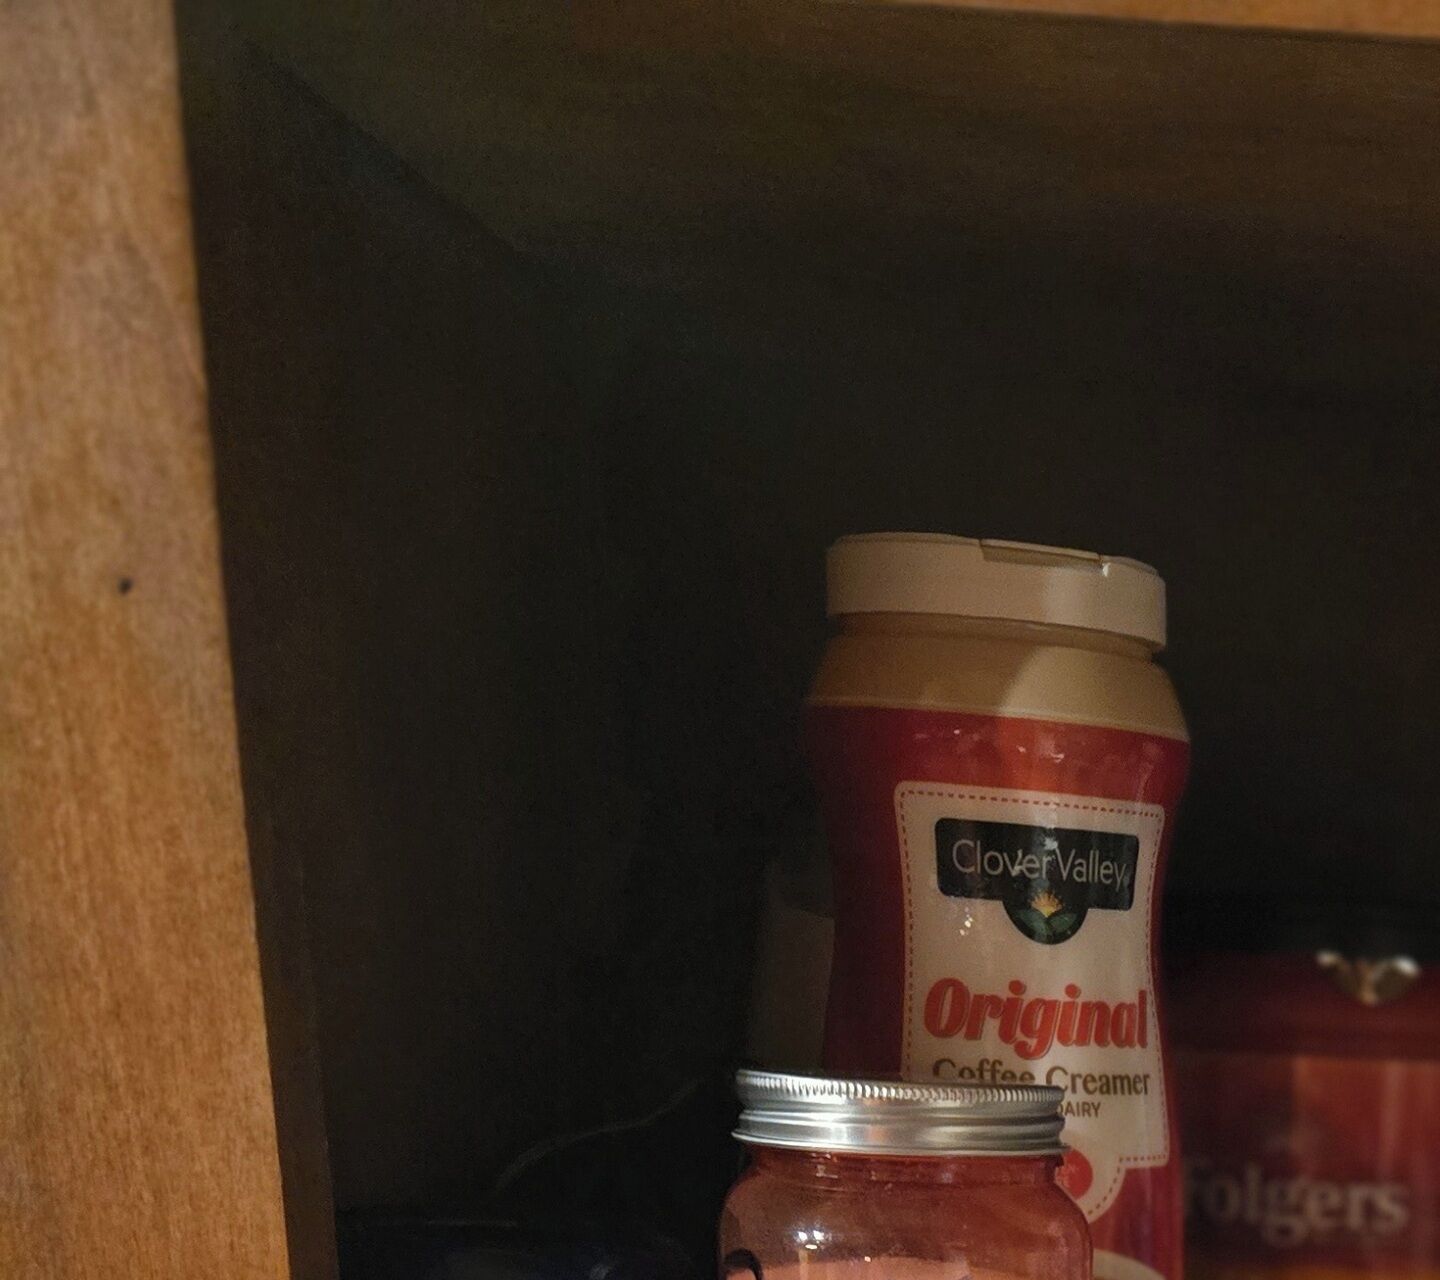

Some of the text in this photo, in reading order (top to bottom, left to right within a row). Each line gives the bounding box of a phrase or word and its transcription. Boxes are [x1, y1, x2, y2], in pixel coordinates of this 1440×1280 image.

[952, 838, 1127, 893] Clover Valley
[923, 976, 1150, 1061] Original
[1045, 1065, 1151, 1097] Creamer
